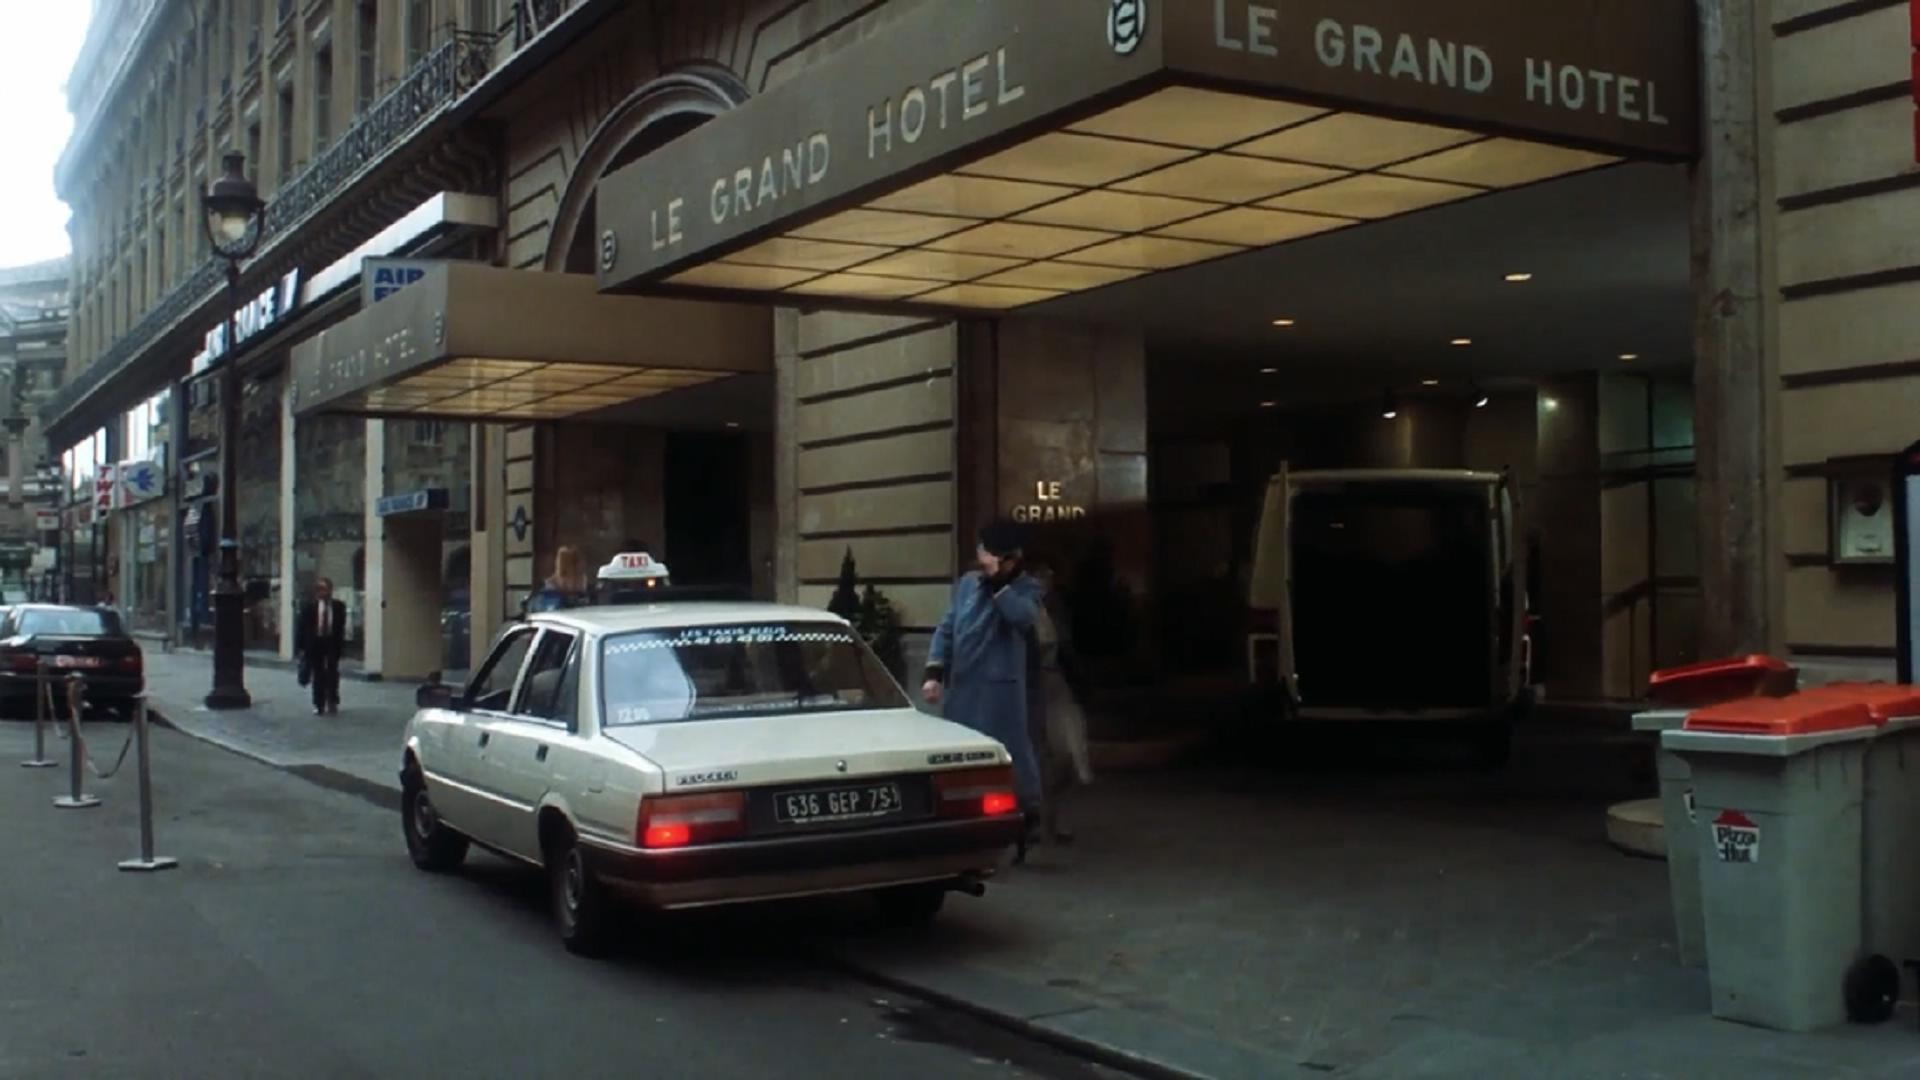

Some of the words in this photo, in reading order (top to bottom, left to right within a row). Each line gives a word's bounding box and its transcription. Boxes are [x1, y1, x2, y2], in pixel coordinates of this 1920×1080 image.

[1213, 0, 1279, 57] LE
[1315, 18, 1494, 94] GRAND
[1525, 57, 1669, 126] HOTEL
[650, 198, 684, 250] LE
[710, 132, 831, 226] GRAND
[866, 46, 1026, 160] HOTEL
[1036, 480, 1062, 500] LE
[1011, 504, 1086, 523] GRAND
[621, 555, 649, 569] TAXI
[786, 794, 820, 817] 636
[828, 791, 860, 814] GEP
[1717, 826, 1758, 847] Pizza
